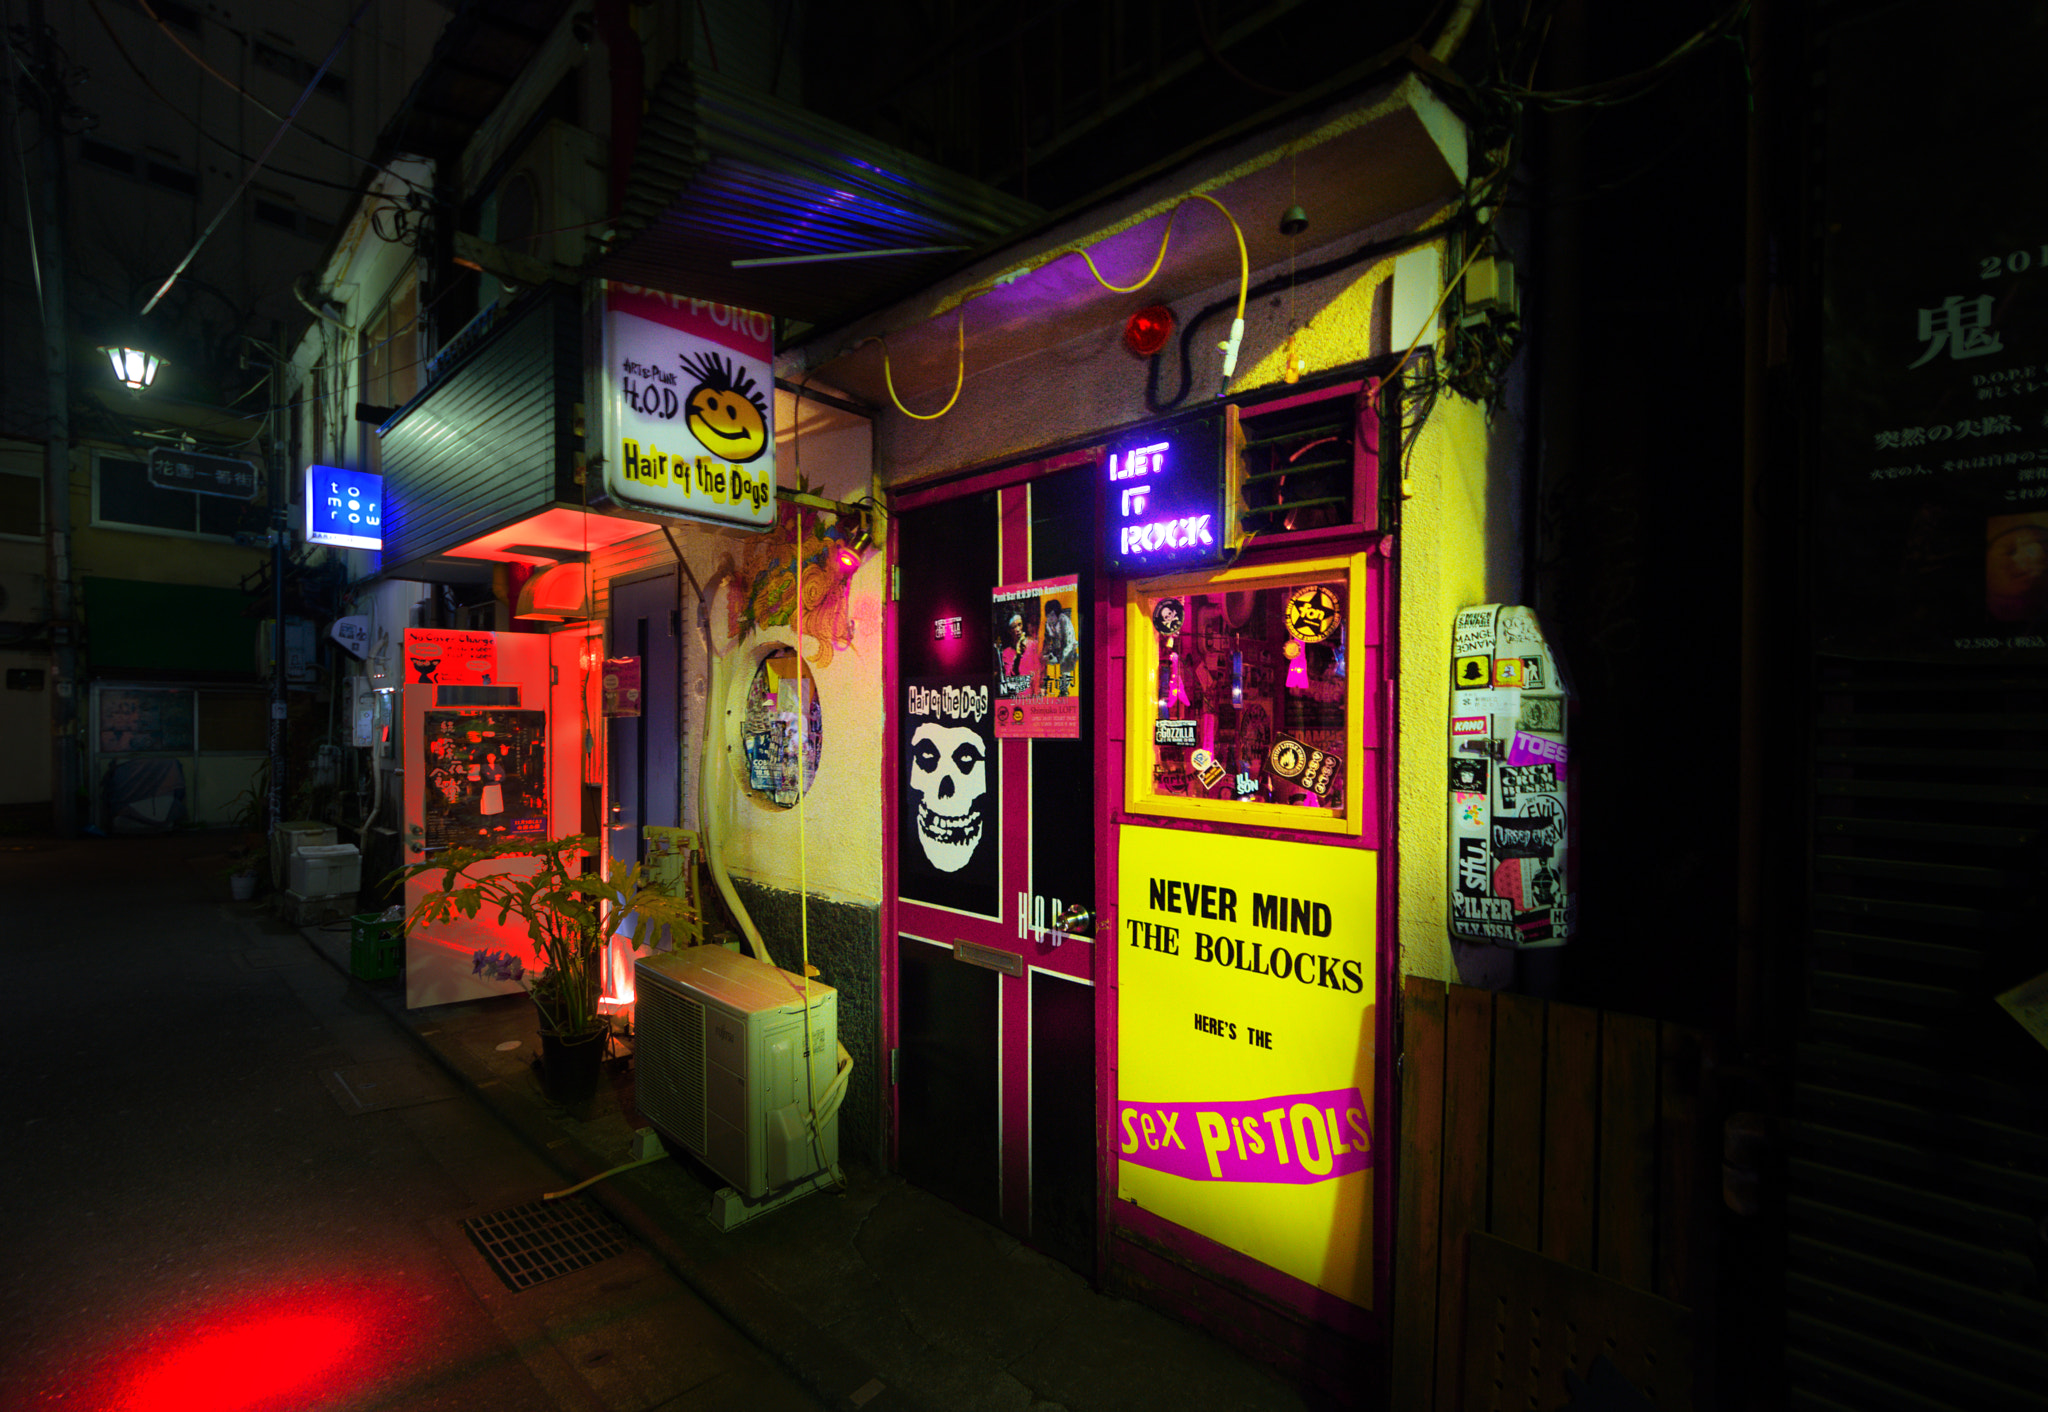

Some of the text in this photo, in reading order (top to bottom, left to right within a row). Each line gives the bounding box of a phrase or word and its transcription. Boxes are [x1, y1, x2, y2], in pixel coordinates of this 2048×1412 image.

[1909, 293, 2005, 370] 鬼
[622, 376, 679, 420] H.O.D
[624, 443, 769, 510] Hair of the Dogs
[1109, 441, 1169, 481] LET
[1121, 485, 1150, 517] IT
[1121, 514, 1213, 555] ROCK
[1298, 602, 1325, 621] fon
[909, 685, 988, 723] Hair of the Dogs
[1517, 732, 1567, 763] TOES
[1149, 877, 1333, 938] NEVER MIND
[1452, 890, 1513, 921] PILFER
[1126, 919, 1364, 995] THE BOLLOCKS
[1194, 1013, 1273, 1051] HERE'S THE
